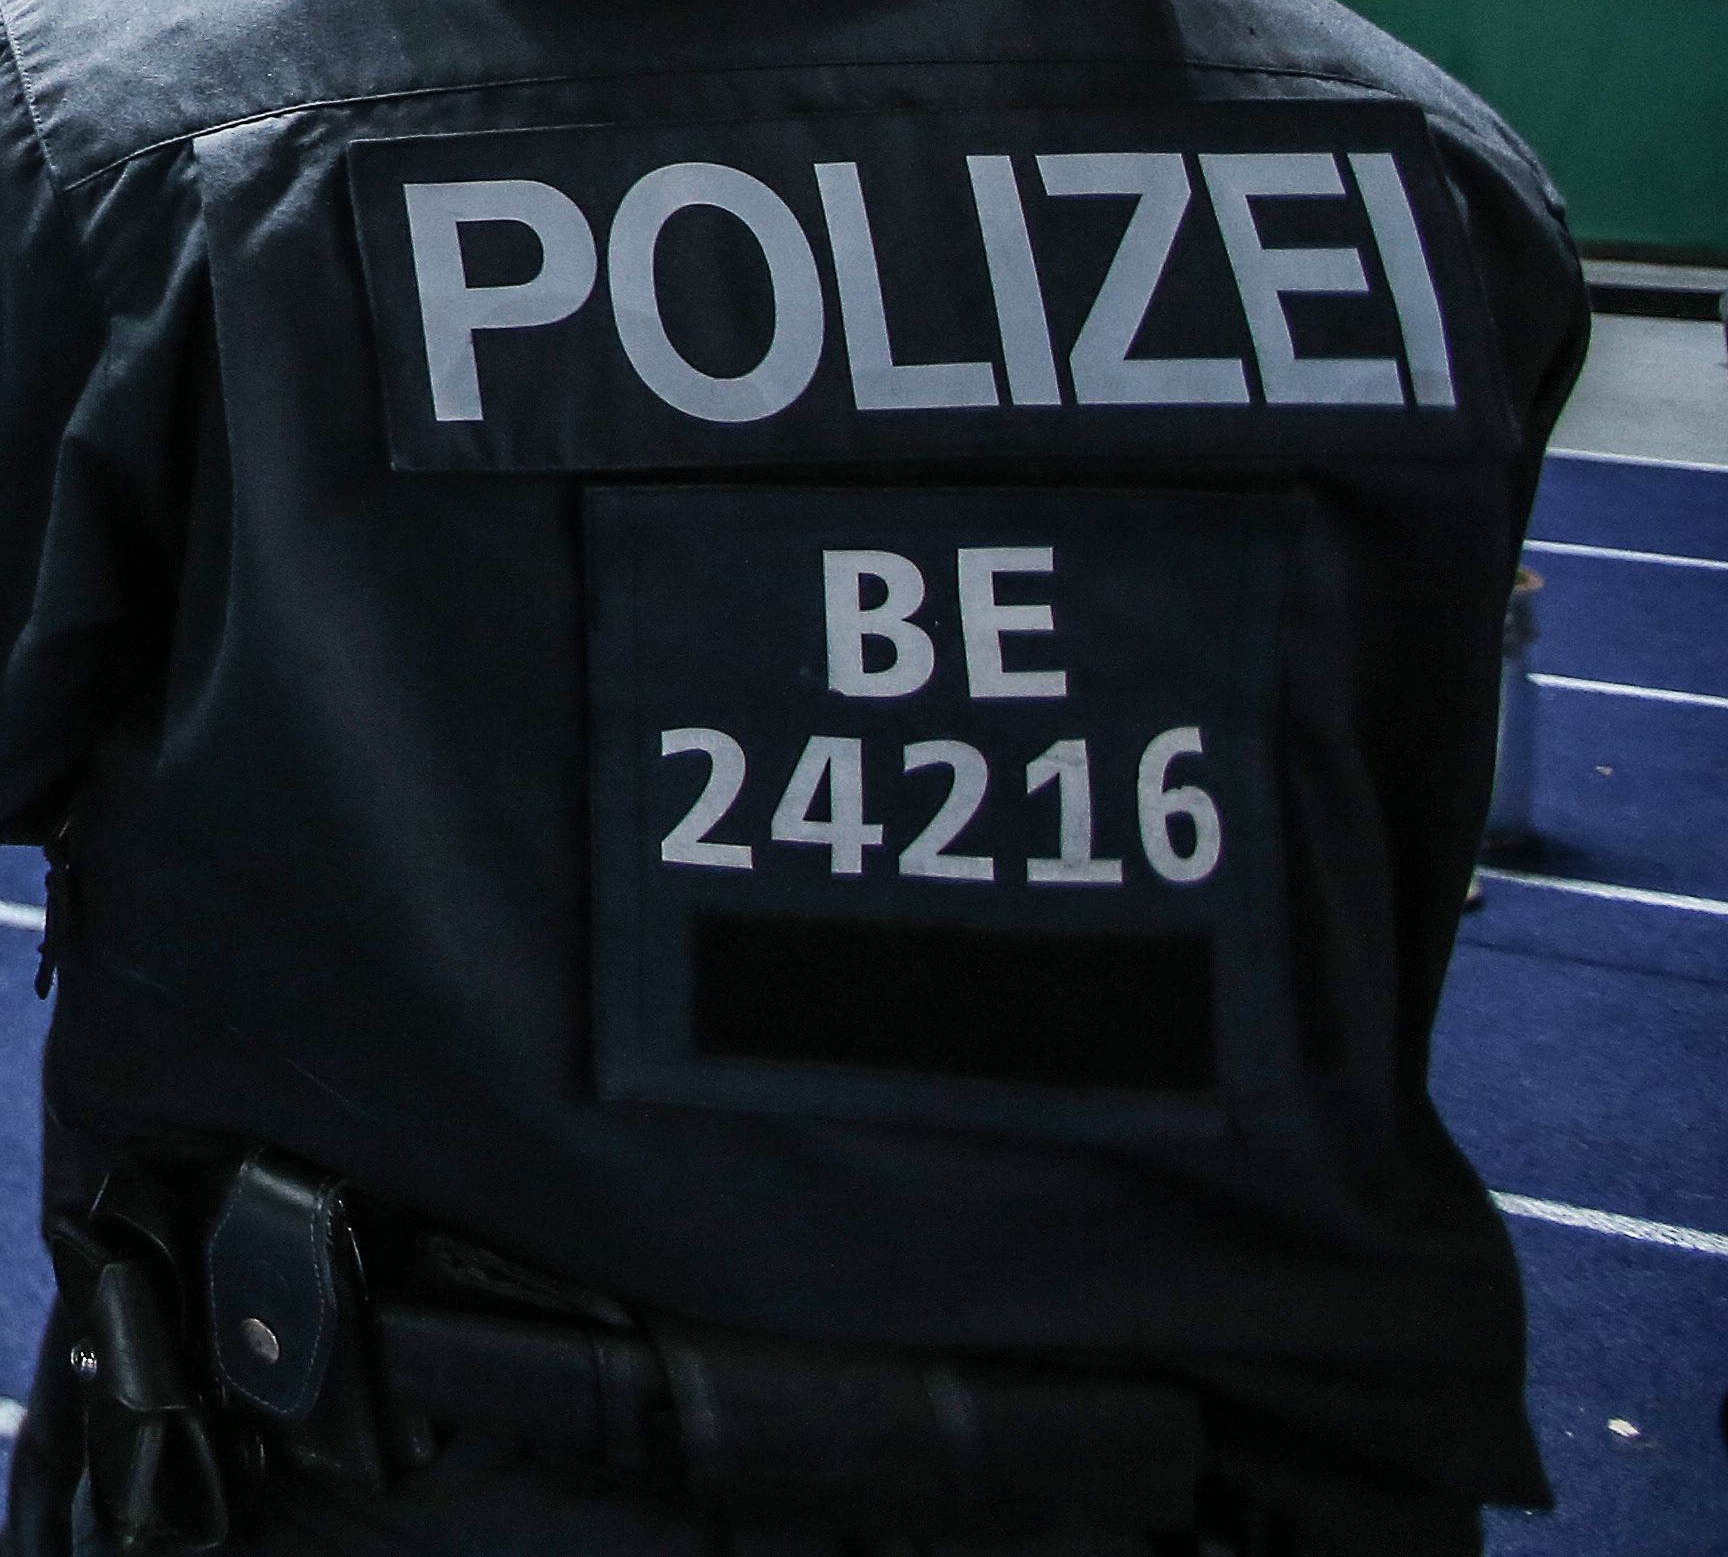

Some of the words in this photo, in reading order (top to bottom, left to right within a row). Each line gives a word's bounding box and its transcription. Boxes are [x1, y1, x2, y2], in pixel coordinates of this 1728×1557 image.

[404, 153, 1455, 422] POLIZEI
[824, 547, 1066, 697] BE
[661, 727, 1221, 883] 24216
